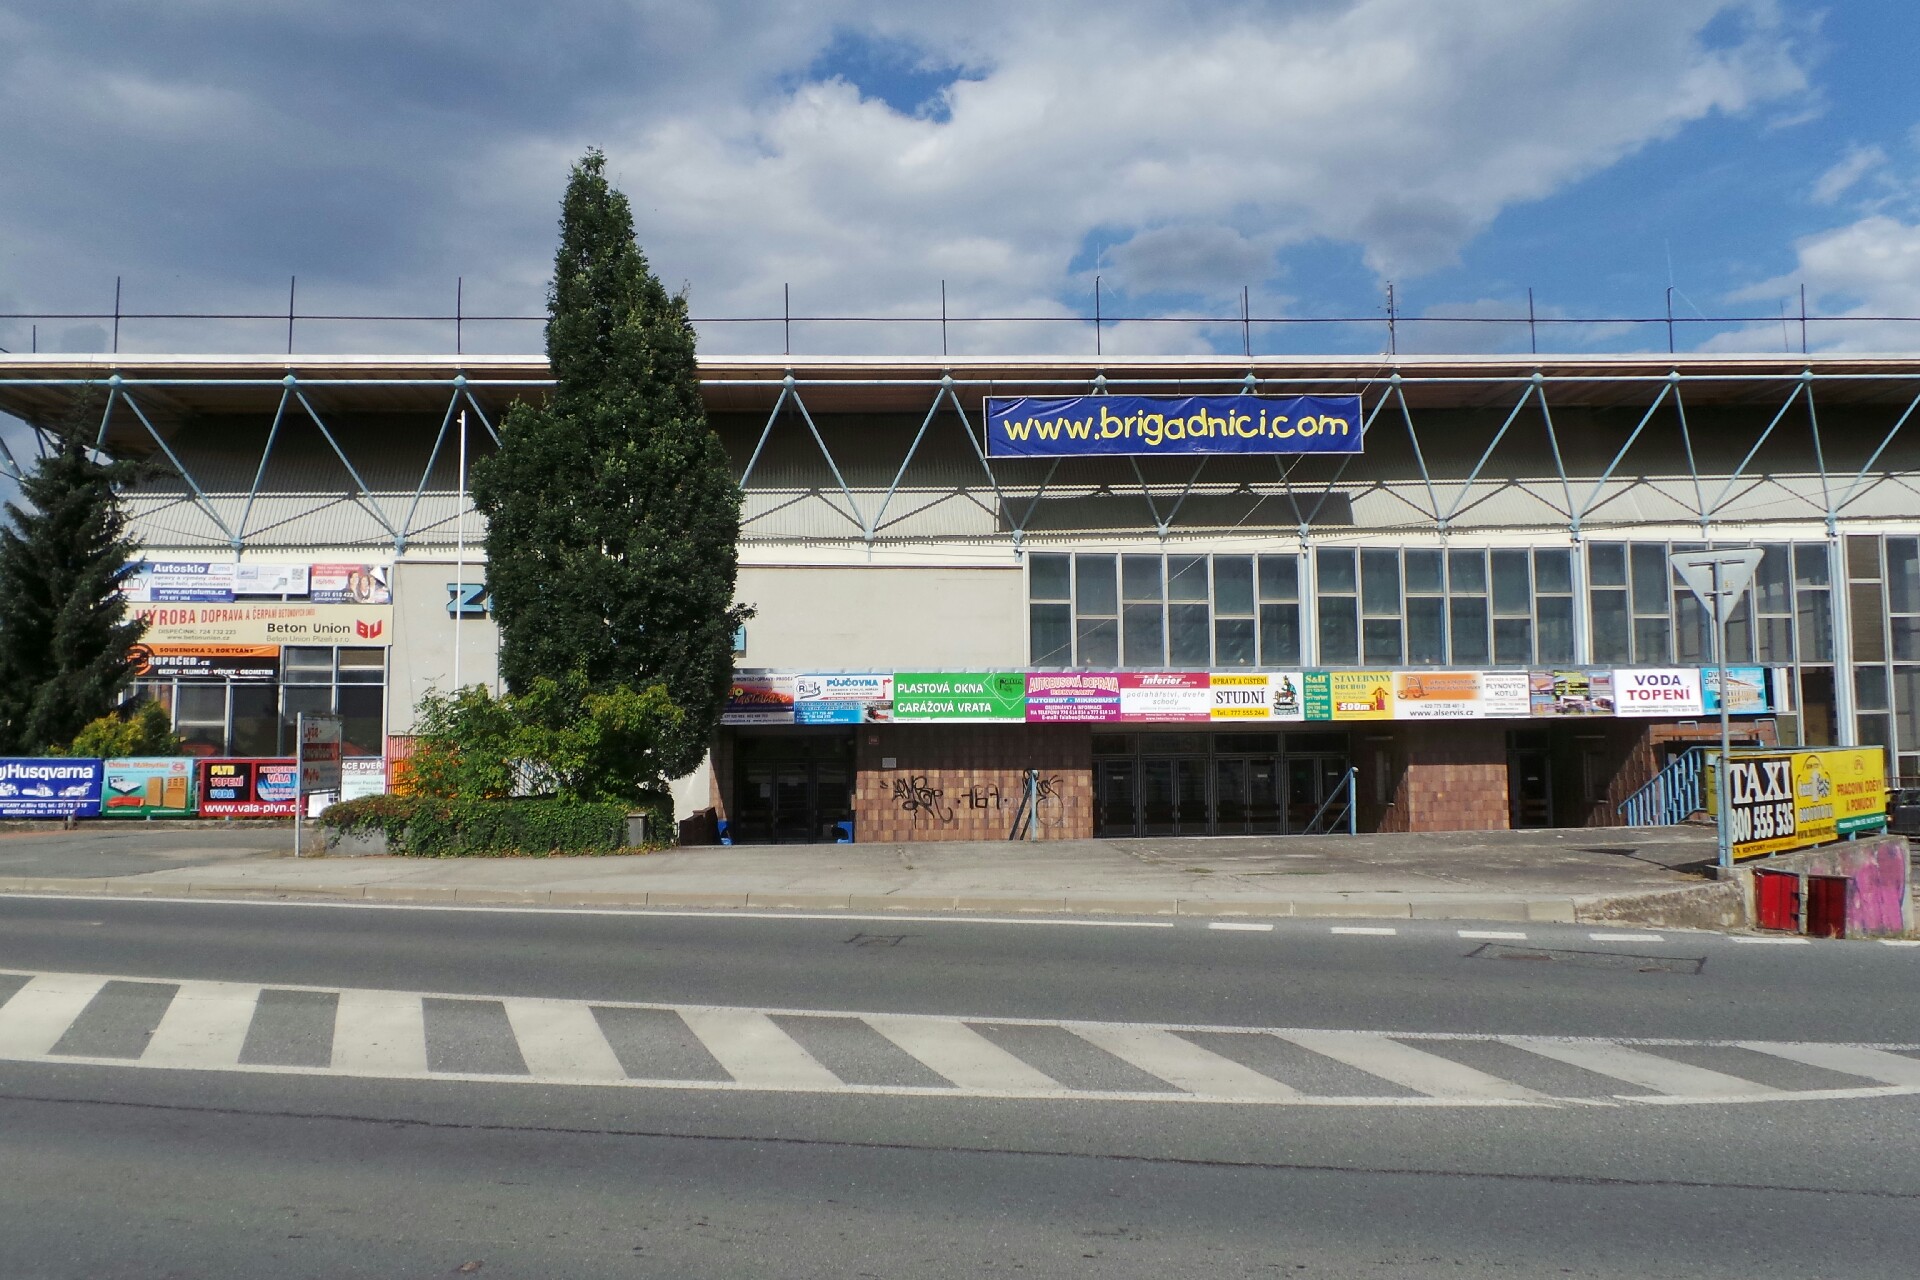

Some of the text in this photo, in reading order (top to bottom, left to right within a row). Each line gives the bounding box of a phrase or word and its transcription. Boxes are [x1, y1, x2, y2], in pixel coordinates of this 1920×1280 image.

[1003, 405, 1349, 446] www.brigadnici.com
[153, 564, 205, 573] Autosklo
[159, 588, 227, 596] www.autoluma.cz
[135, 604, 196, 626] VÝROBA
[201, 608, 243, 623] DOPRAVA
[245, 610, 250, 620] A
[267, 623, 350, 634] Beton Union
[356, 619, 383, 639] BU
[826, 678, 879, 687] PŮJČOVNA
[1028, 675, 1082, 693] AUTOBUSOVÁ
[1081, 676, 1120, 693] DOPRAVA
[1635, 675, 1682, 686] VODA
[897, 681, 984, 693] PLASTOVÁ OKNA
[1494, 689, 1518, 697] KOTLŮ
[1627, 686, 1690, 700] TOPENÍ
[1216, 688, 1265, 704] STUDNÍ
[897, 700, 955, 712] GARÁŽOVÁ
[957, 702, 992, 712] VRATA
[1340, 702, 1370, 711] 500m
[211, 765, 235, 775] PLYN
[360, 761, 385, 770] DVEŘÍ
[7, 764, 93, 780] Husqvarna
[267, 773, 291, 783] VÁLA
[210, 775, 244, 787] TOPENÍ
[1730, 761, 1792, 804] TAXI
[210, 789, 235, 799] VODA
[1754, 805, 1774, 839] 555
[1776, 803, 1794, 835] 535
